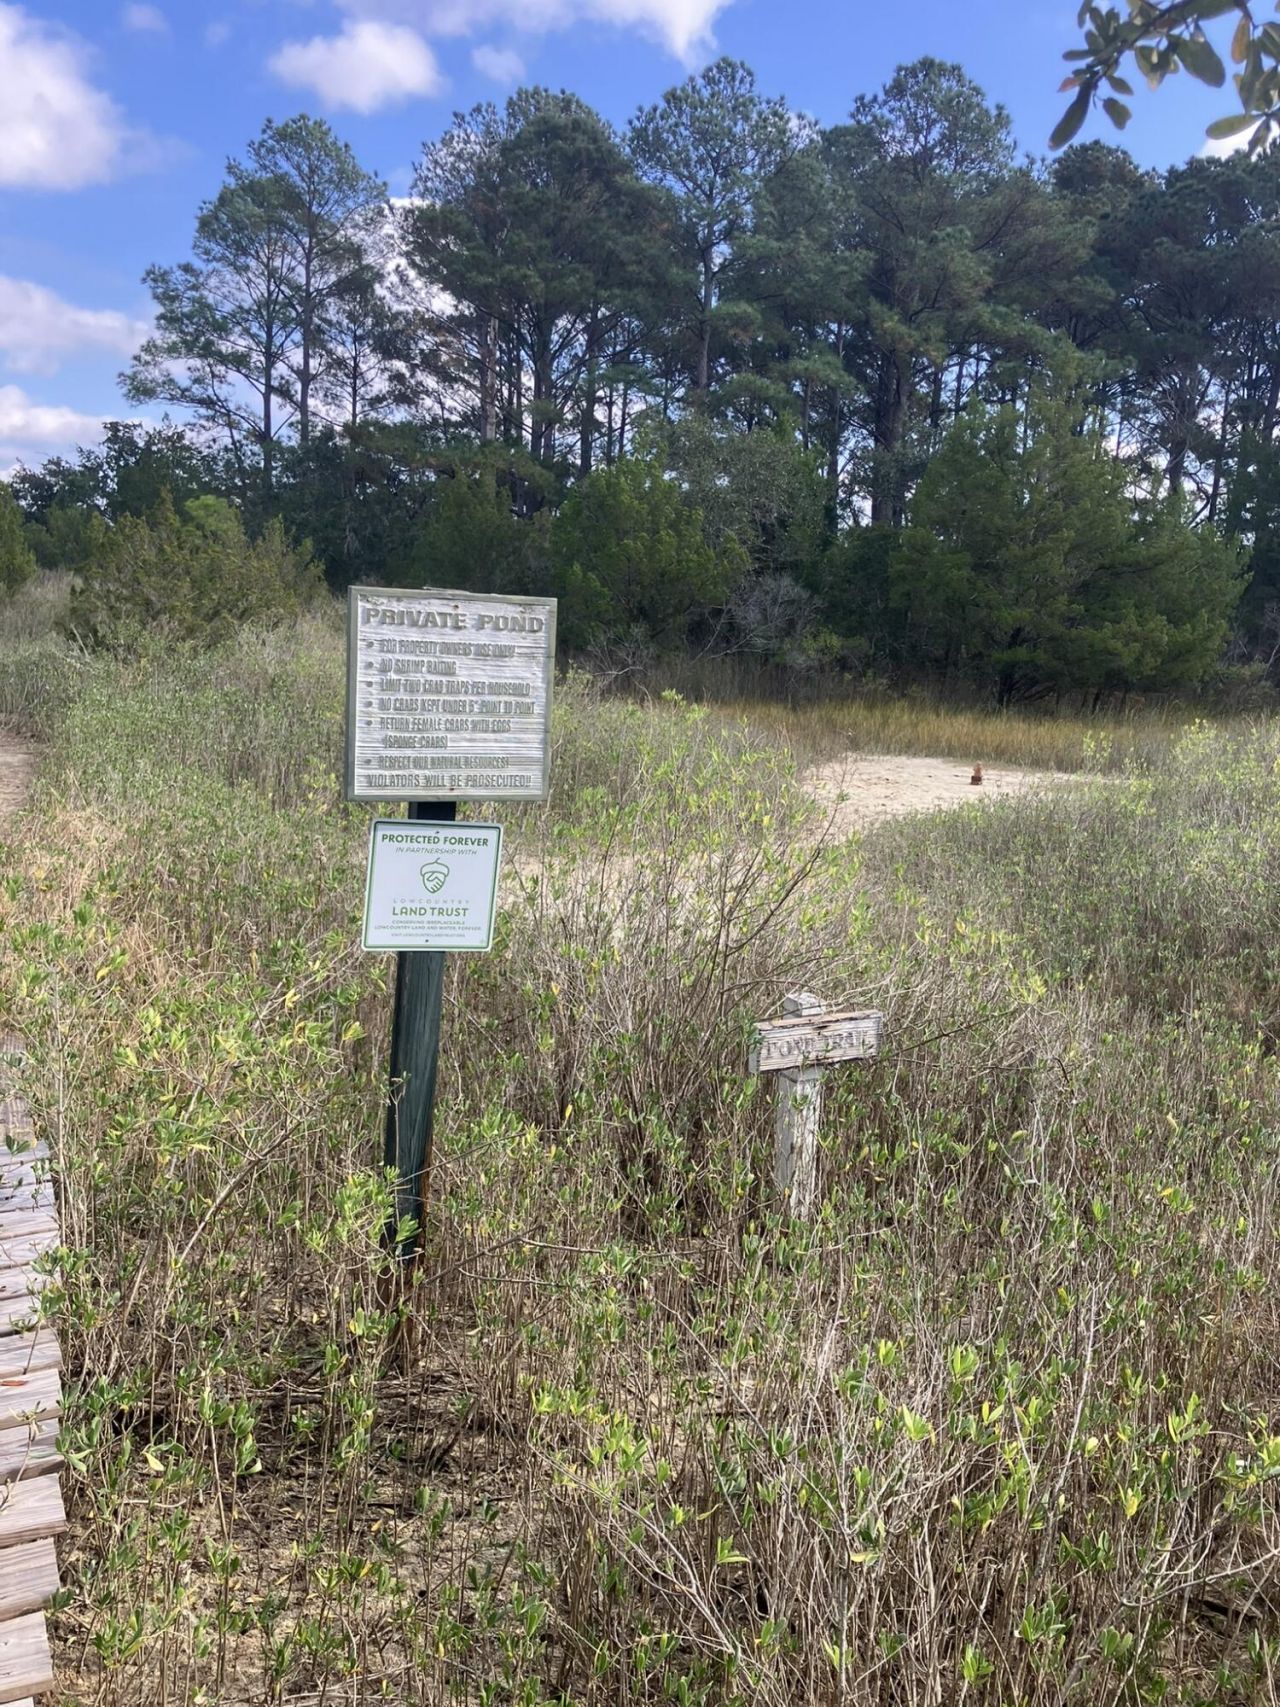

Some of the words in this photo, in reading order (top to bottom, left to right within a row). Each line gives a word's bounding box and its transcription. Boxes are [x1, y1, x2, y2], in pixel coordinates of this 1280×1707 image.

[365, 607, 467, 630] PRIVATE
[476, 613, 545, 633] POND
[380, 639, 397, 653] FOR
[399, 640, 438, 655] PROPERTY
[379, 658, 393, 672] NO
[394, 659, 426, 674] SHRIMP
[426, 660, 457, 675] BAITING
[380, 677, 402, 692] LIMIT
[403, 679, 421, 693] TWO
[422, 680, 445, 694] CRAB
[445, 681, 470, 695] TRAPS
[471, 681, 486, 695] PER
[487, 682, 531, 696] HOUSEHOLD
[378, 697, 392, 711] NO
[393, 698, 419, 712] CRABS
[420, 698, 441, 713] KEPT
[442, 699, 467, 714] UNDER
[479, 700, 502, 714] POINT
[503, 701, 513, 714] TO
[513, 701, 535, 715] POINT
[379, 716, 410, 730] RETURN
[411, 717, 442, 732] FEMALE
[443, 718, 470, 732] CRABS
[470, 719, 490, 733] WITH
[490, 719, 512, 733] EGGS
[384, 735, 417, 749] (SPONGE
[419, 735, 448, 750] CRABS)
[378, 755, 411, 770] RESPECT
[413, 756, 429, 770] OUR
[430, 756, 463, 770] NATURAL
[368, 774, 420, 787] VIOLATORS
[425, 774, 447, 787] WILL
[450, 774, 462, 787] BE
[381, 834, 440, 845] PROTECTED
[443, 836, 489, 847] FOREVER
[405, 847, 456, 855] PARTNERSHIP
[392, 907, 427, 916] LAND
[430, 907, 469, 917] TRUST
